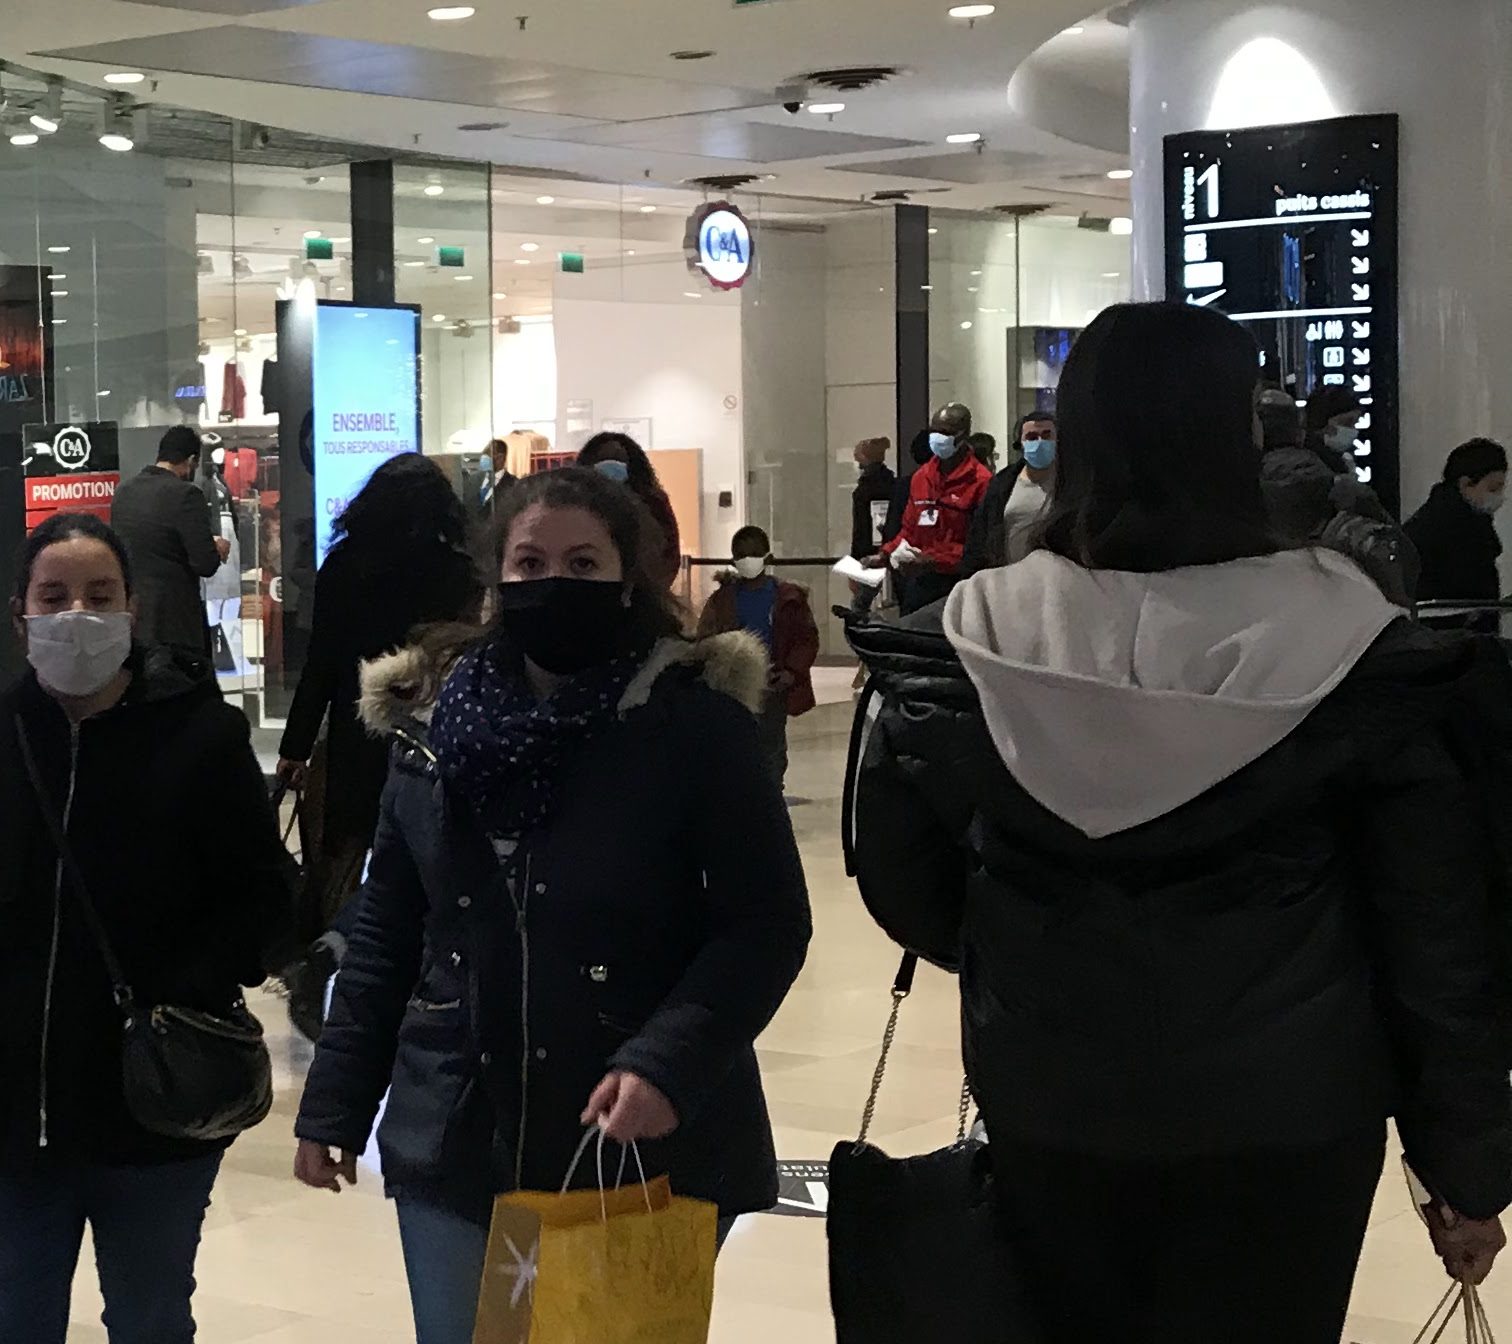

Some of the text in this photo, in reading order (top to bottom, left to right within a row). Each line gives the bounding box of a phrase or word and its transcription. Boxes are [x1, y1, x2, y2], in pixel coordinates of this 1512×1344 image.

[1197, 163, 1219, 218] 1
[706, 225, 745, 264] C&A
[332, 413, 400, 435] ENSEMBLE,
[59, 438, 85, 457] C&A
[323, 440, 409, 454] TOUS RESPONSABLES
[32, 481, 115, 501] PROMOTION
